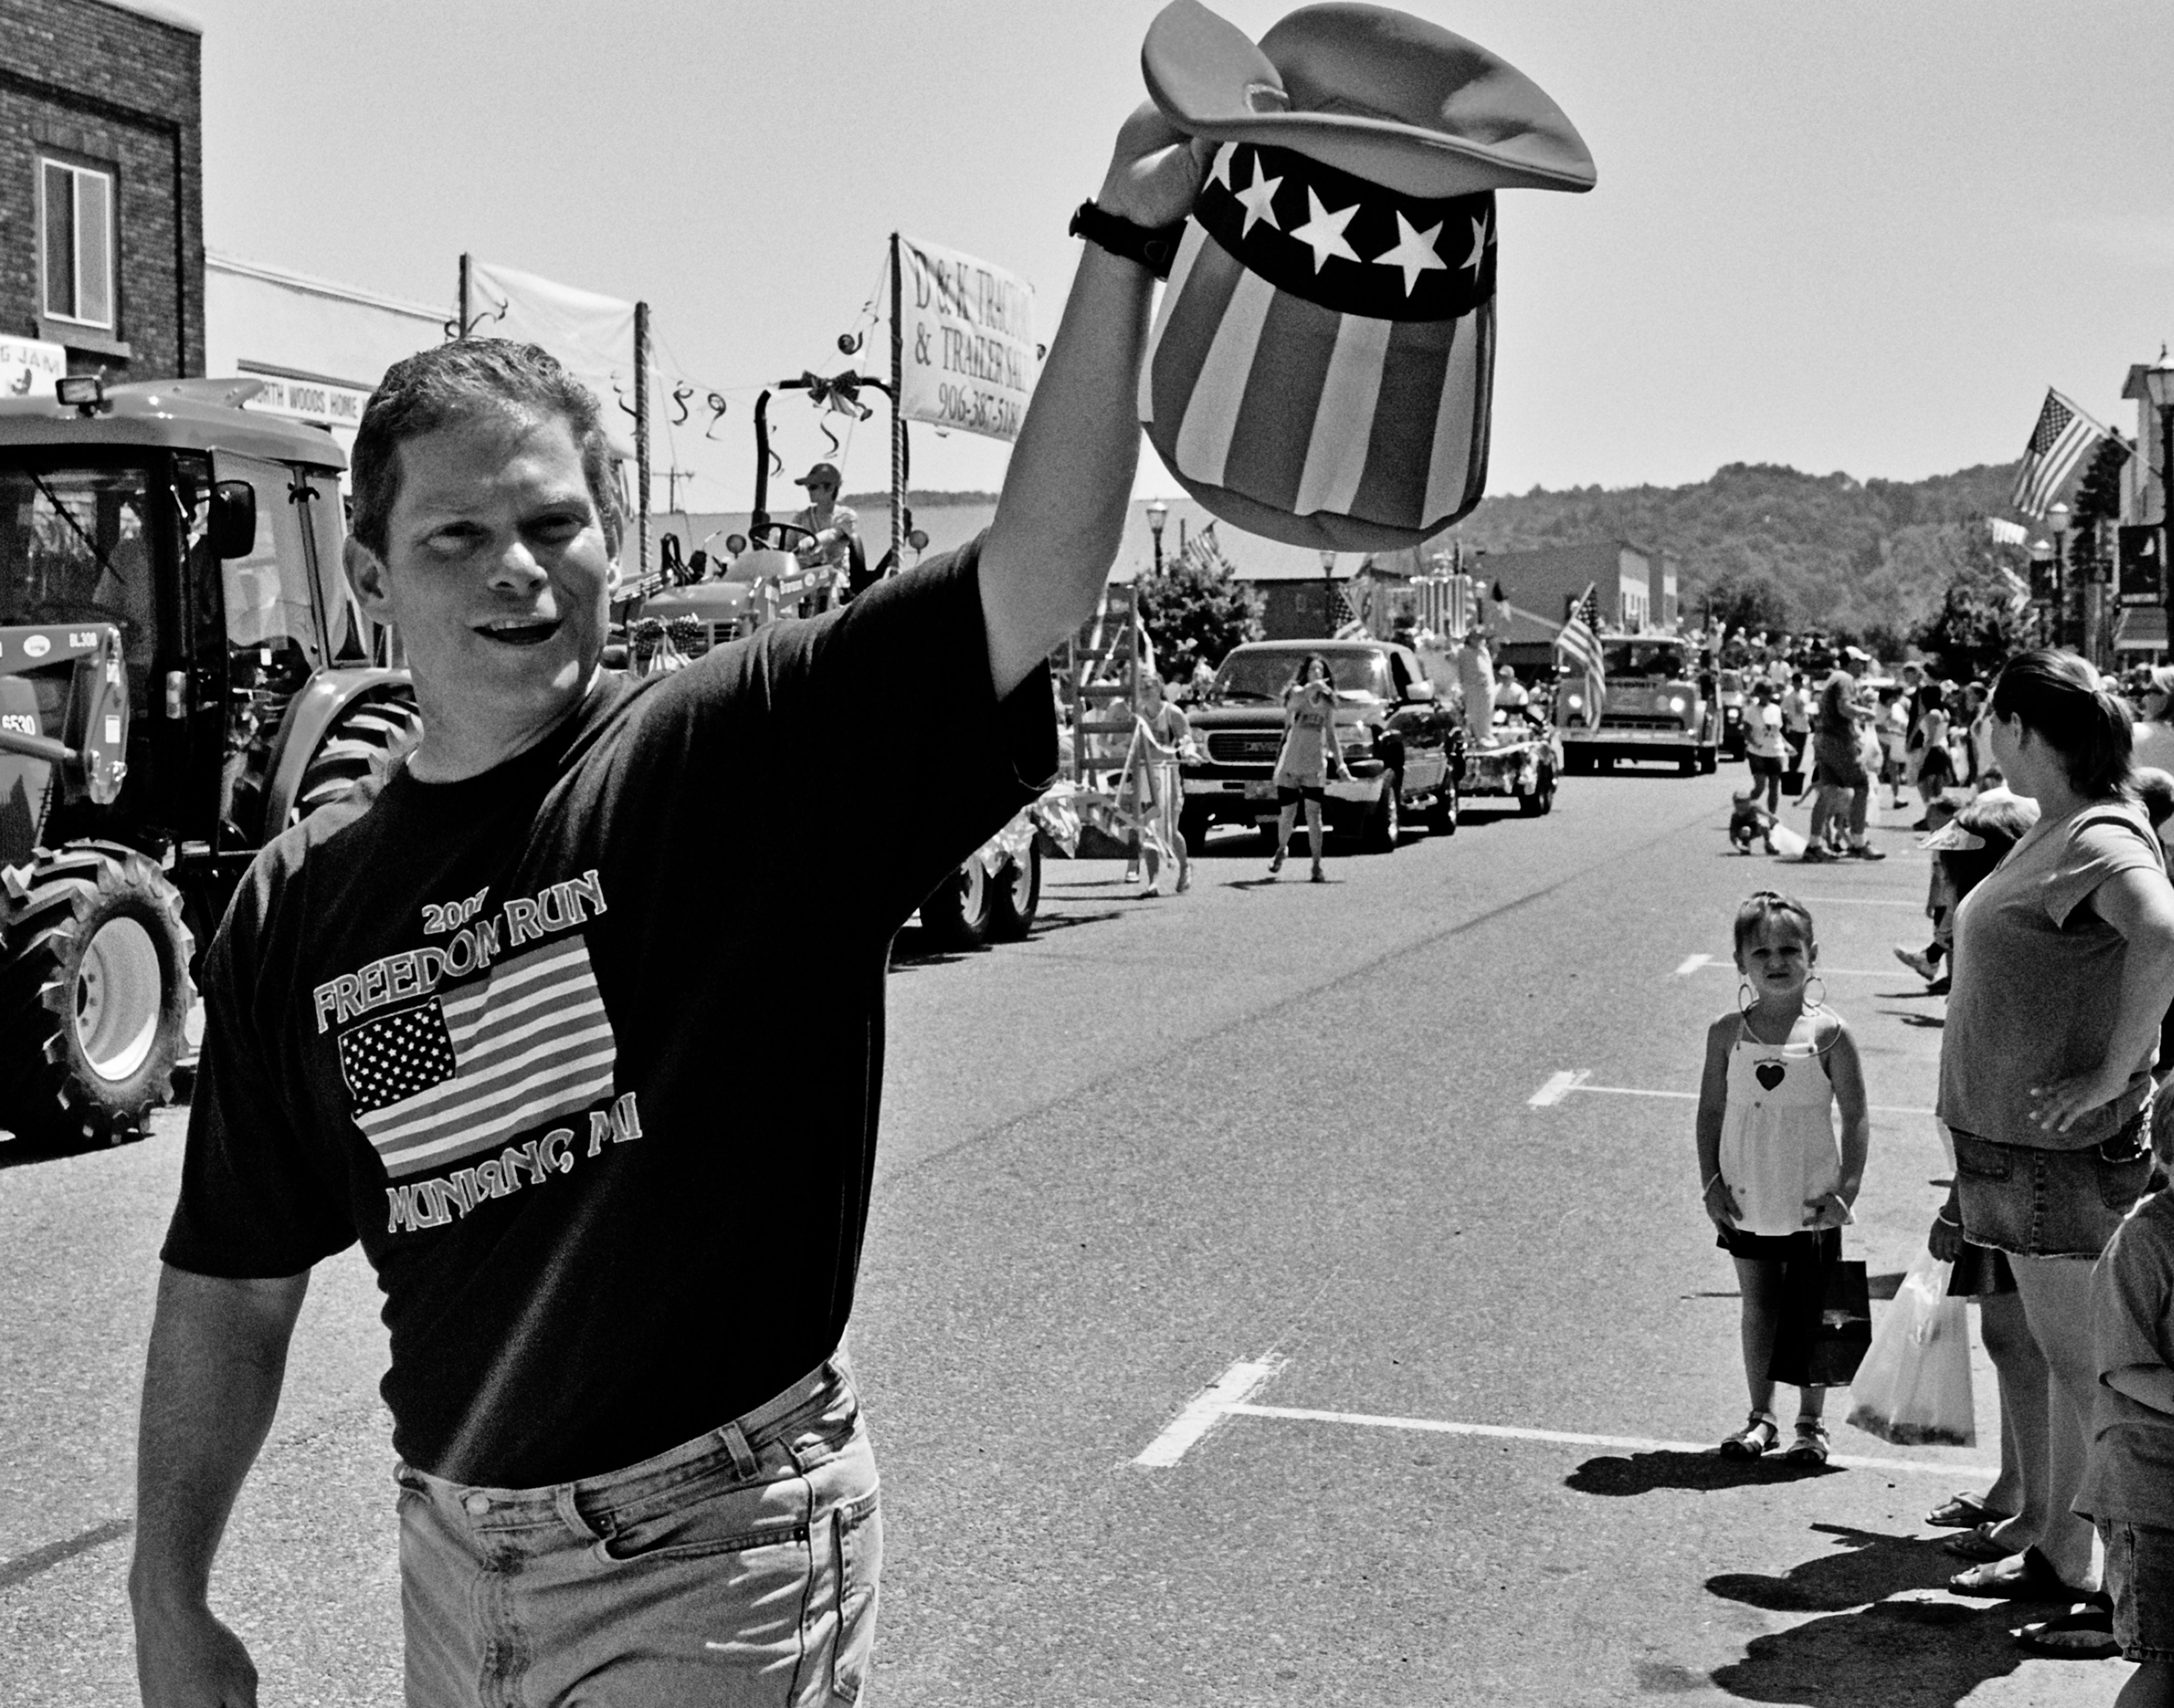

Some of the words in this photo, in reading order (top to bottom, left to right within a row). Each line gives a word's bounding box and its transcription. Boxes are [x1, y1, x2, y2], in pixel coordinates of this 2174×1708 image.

[18, 347, 61, 377] JAM
[915, 321, 931, 366] &
[253, 381, 284, 407] RTH
[289, 386, 325, 414] WOODS
[330, 393, 357, 419] HOME
[2, 714, 36, 736] 6530
[422, 886, 490, 934] 2007
[313, 913, 503, 1034] FREEDOM
[504, 869, 607, 947] RUN
[587, 1091, 643, 1157] MI
